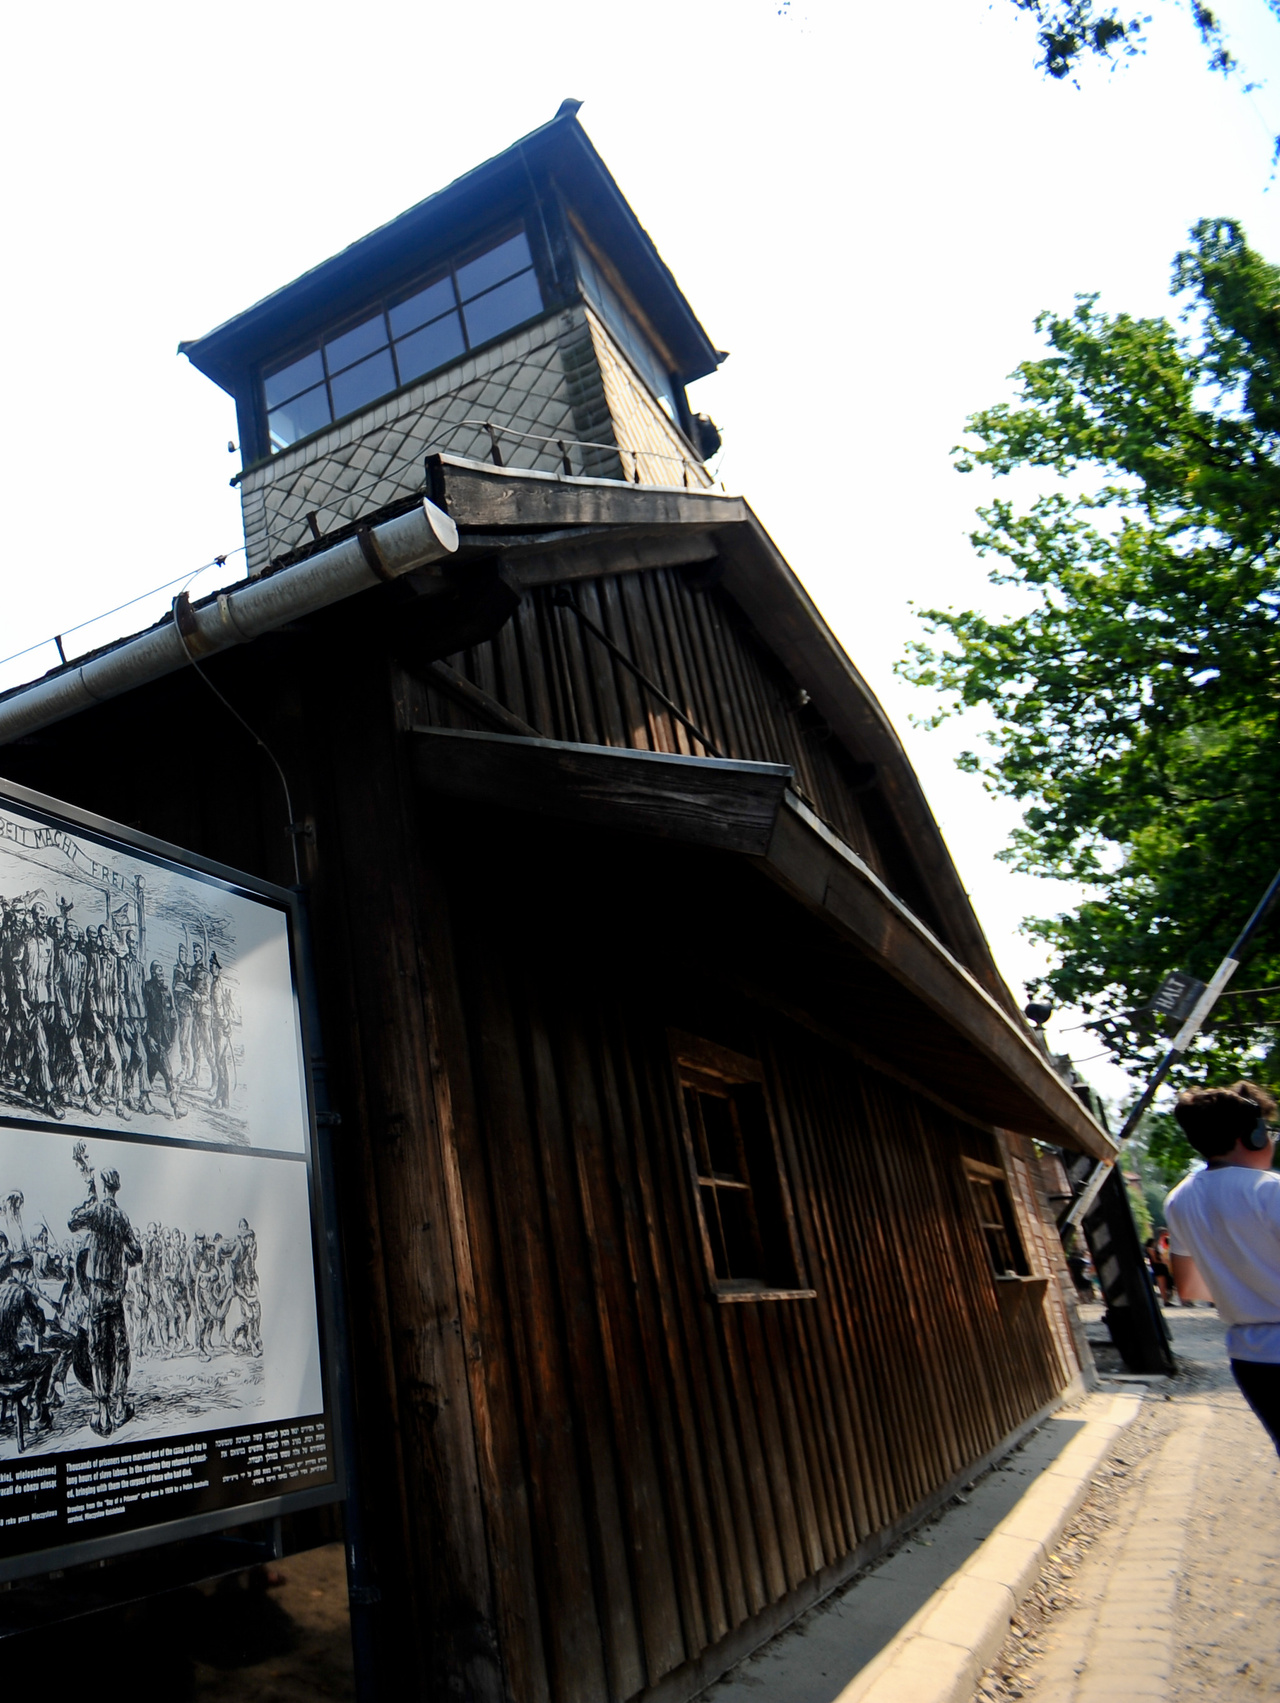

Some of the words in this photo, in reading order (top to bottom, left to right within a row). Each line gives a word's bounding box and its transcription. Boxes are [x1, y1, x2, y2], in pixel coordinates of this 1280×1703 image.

[33, 829, 80, 862] MACHT
[91, 860, 126, 890] FREI
[1155, 977, 1186, 1009] HALT
[66, 1460, 92, 1472] Thousands
[92, 1459, 98, 1468] of
[99, 1457, 120, 1468] prisoners
[121, 1455, 132, 1463] were
[132, 1451, 151, 1461] marched
[160, 1448, 165, 1457] of
[165, 1448, 173, 1456] the
[184, 1444, 194, 1453] each
[194, 1443, 202, 1451] day
[66, 1476, 78, 1485] long
[78, 1474, 93, 1483] hours
[93, 1471, 99, 1481] of
[99, 1471, 112, 1480] slave
[135, 1465, 143, 1473] the
[143, 1462, 161, 1472] evening
[161, 1460, 171, 1469] they
[171, 1456, 190, 1467] returned
[14, 1484, 22, 1494] do
[23, 1483, 39, 1493] obozu
[40, 1480, 57, 1490] niosąc
[15, 1465, 57, 1480] wielogodzinnej
[75, 1486, 96, 1497] bringing
[96, 1483, 107, 1493] with
[108, 1482, 121, 1491] them
[121, 1480, 129, 1488] the
[129, 1477, 146, 1487] corpses
[146, 1475, 151, 1484] of
[151, 1474, 164, 1483] those
[164, 1471, 173, 1480] who
[173, 1469, 182, 1478] had
